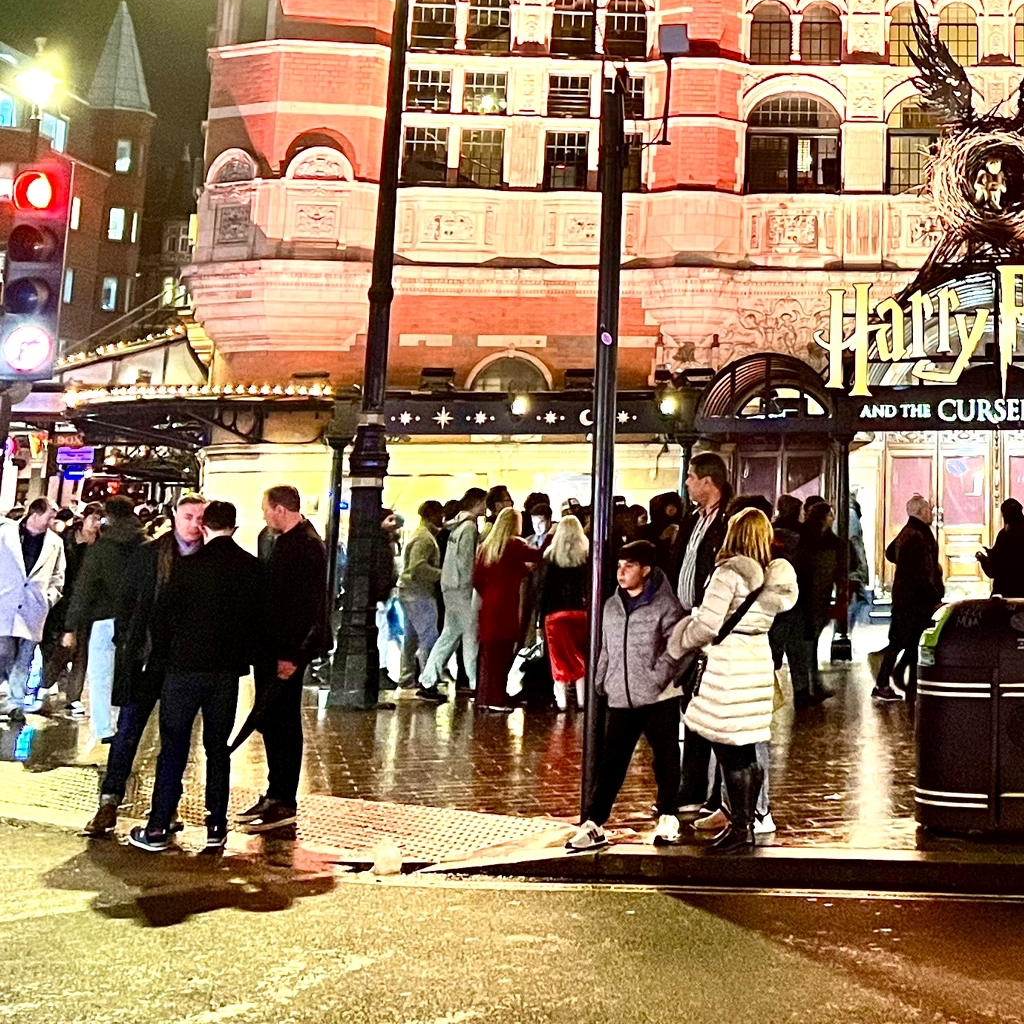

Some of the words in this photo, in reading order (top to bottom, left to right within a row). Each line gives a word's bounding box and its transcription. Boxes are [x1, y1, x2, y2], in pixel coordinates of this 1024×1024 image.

[813, 282, 989, 397] Harry
[859, 404, 898, 419] AND
[899, 403, 932, 418] THE
